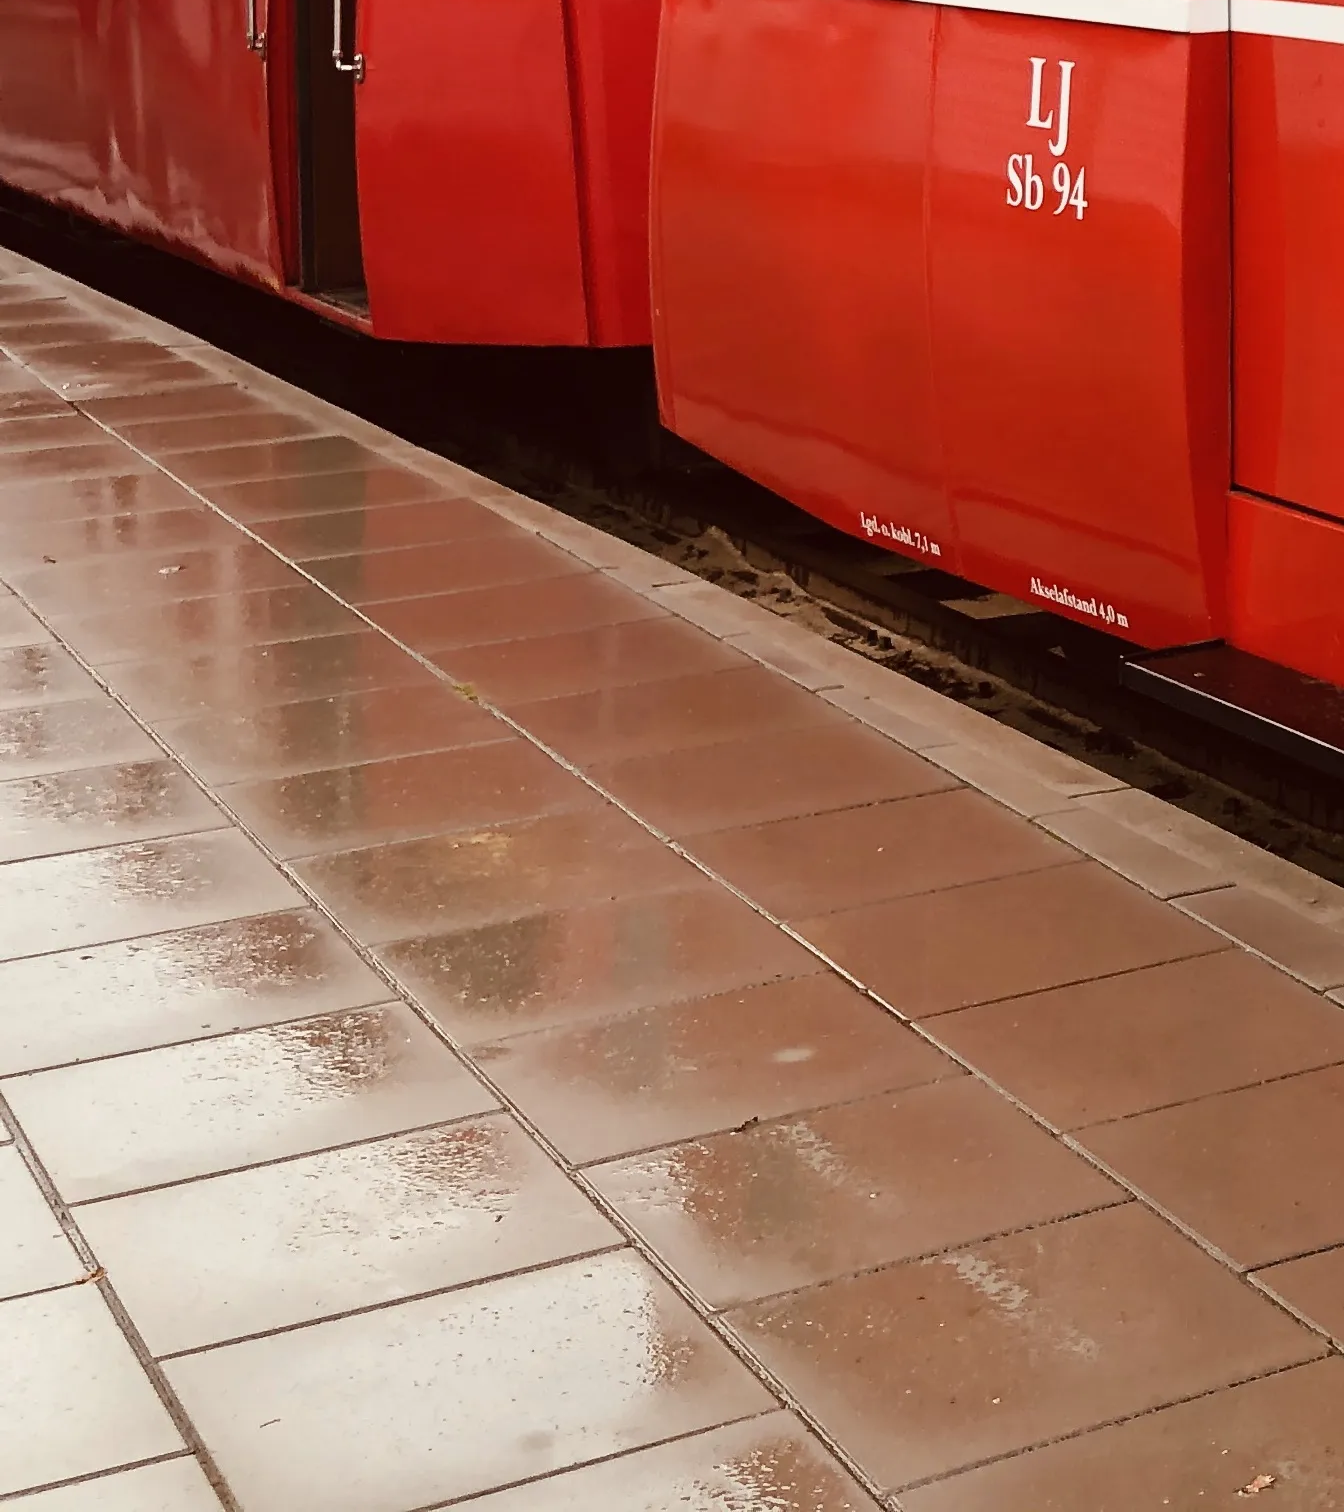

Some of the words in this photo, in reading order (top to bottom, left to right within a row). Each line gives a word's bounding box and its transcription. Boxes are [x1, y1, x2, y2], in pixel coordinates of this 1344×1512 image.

[1026, 57, 1075, 156] LJ
[1007, 154, 1043, 210] Sb
[1052, 163, 1087, 220] 94
[915, 533, 929, 555] 7,1
[930, 543, 941, 556] m
[1030, 577, 1097, 616] Akselafstand
[1099, 603, 1116, 625] 4,0
[1117, 613, 1129, 628] m
